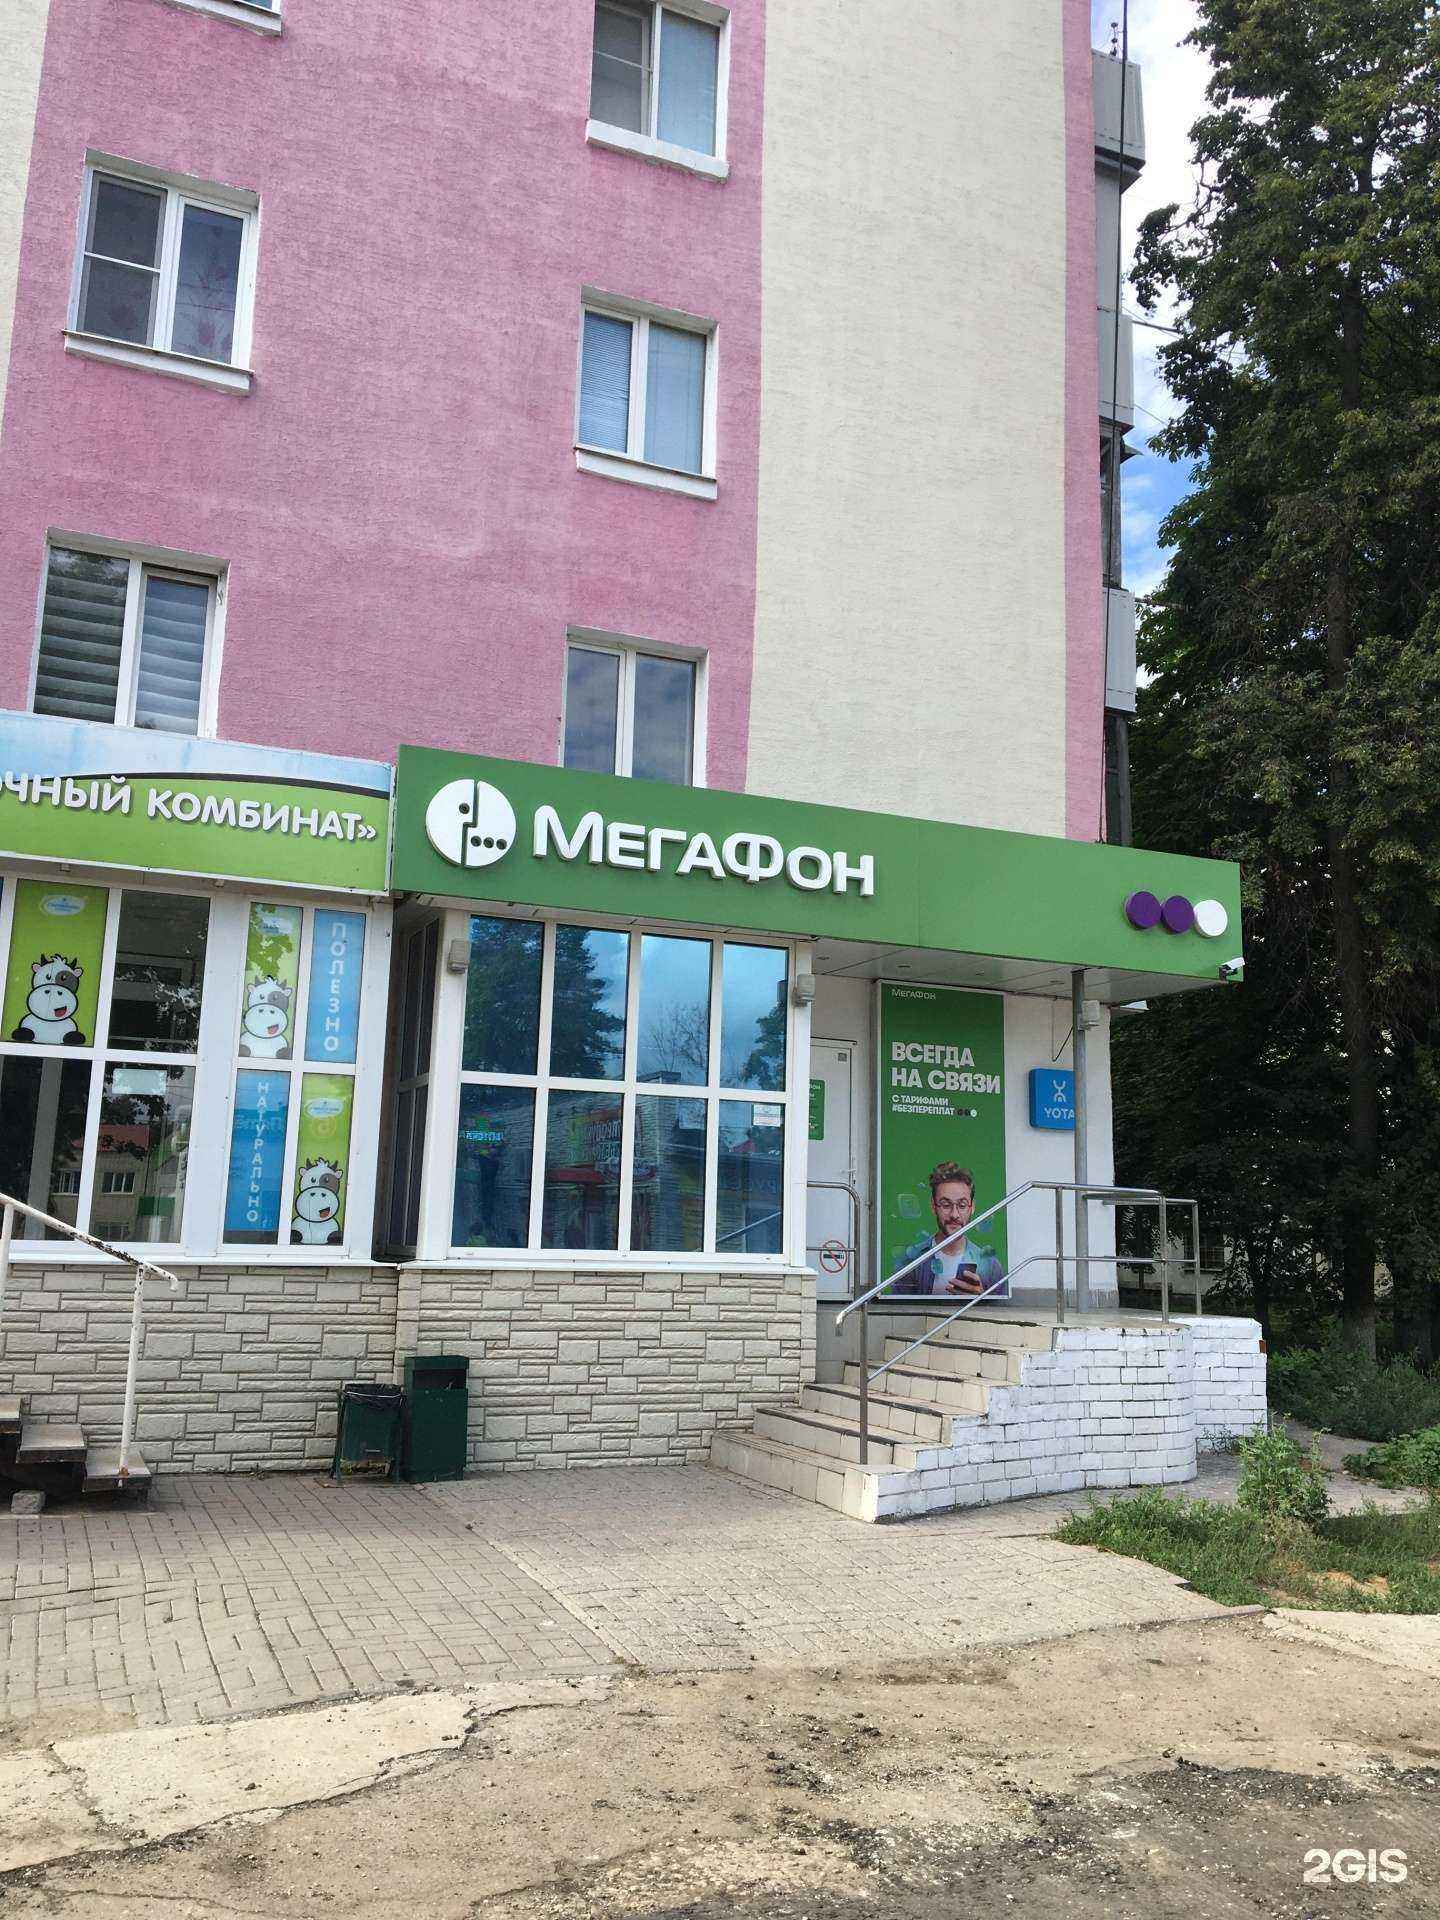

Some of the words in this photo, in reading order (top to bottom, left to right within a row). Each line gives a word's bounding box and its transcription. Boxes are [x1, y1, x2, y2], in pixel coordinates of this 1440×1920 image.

[0, 770, 132, 815] ЧНЫЙ
[147, 788, 377, 841] КОМБИНАТ»
[324, 922, 347, 1051] ПОЛЕЗНО
[891, 1041, 975, 1069] ВСЕГДА
[891, 1067, 923, 1088] НА
[927, 1069, 1001, 1094] СВЯЗИ
[892, 1094, 900, 1103] С
[901, 1094, 949, 1106] ТАРИФАМИ
[892, 1103, 955, 1116] #БЕЗПЕРЕПЛАТ
[1044, 1107, 1075, 1120] YOTA
[246, 1081, 269, 1222] НАТУРАЛЬНО
